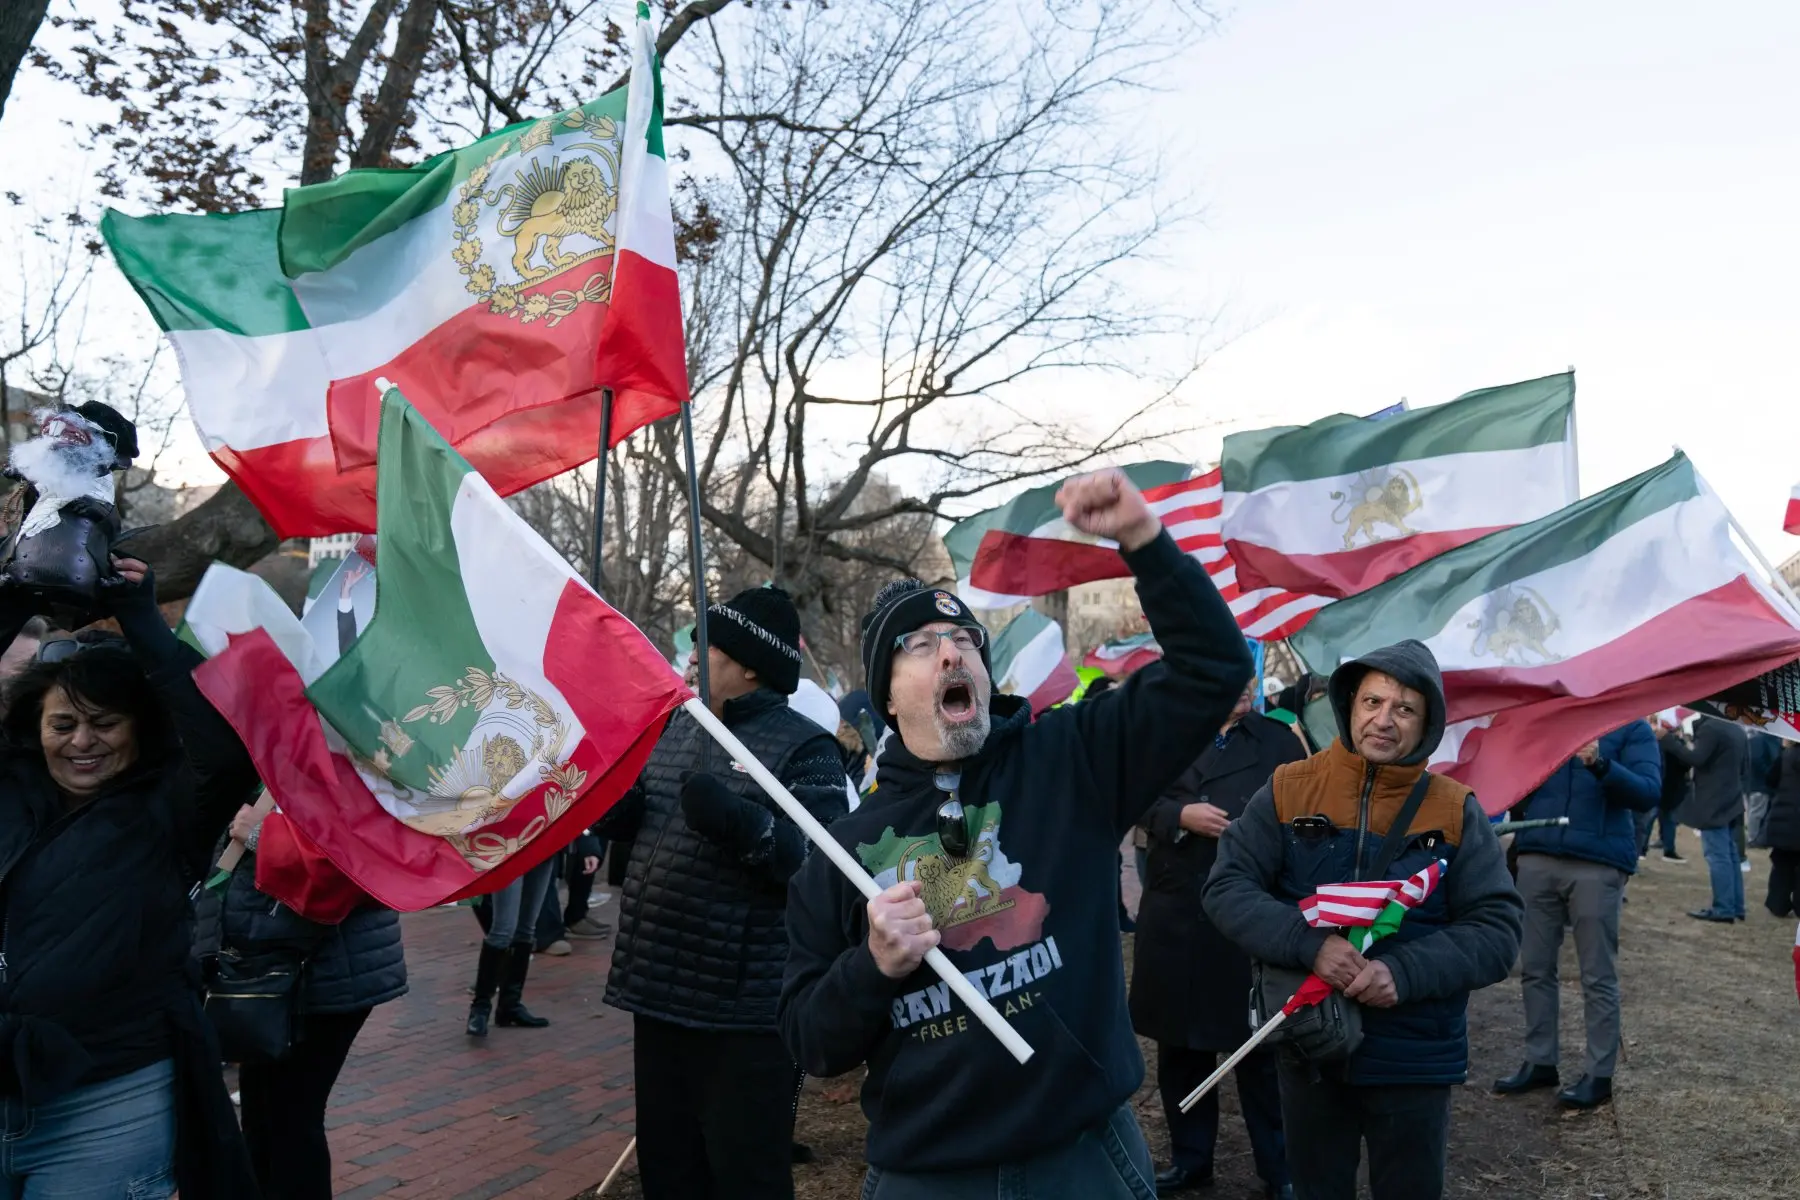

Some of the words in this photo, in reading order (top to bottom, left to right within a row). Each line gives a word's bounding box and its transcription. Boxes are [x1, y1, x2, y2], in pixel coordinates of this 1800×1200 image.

[1776, 676, 1786, 719] FREEDOM
[1784, 674, 1795, 716] STABILITY
[890, 981, 951, 1028] RAN
